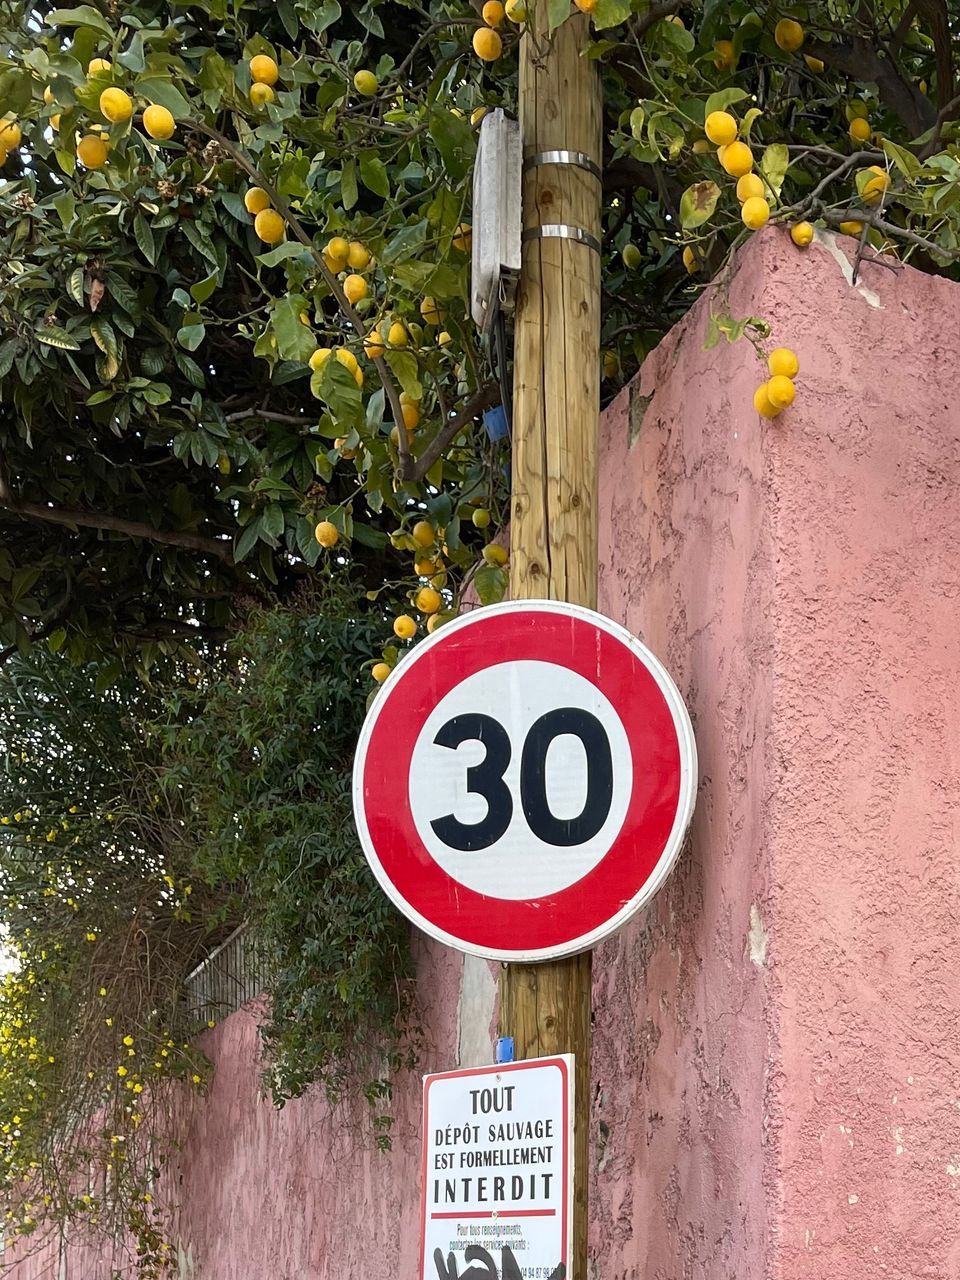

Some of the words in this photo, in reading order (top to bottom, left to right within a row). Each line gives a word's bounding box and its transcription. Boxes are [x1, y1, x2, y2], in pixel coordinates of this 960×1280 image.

[429, 706, 613, 852] 30
[469, 1086, 515, 1114] TOUT
[435, 1122, 480, 1146] DÉPÔT
[488, 1119, 554, 1143] SAUVAGE
[434, 1153, 455, 1170] EST
[460, 1145, 553, 1168] FORMELLEMENT
[434, 1173, 553, 1203] INTERDIT
[457, 1224, 468, 1236] Pour
